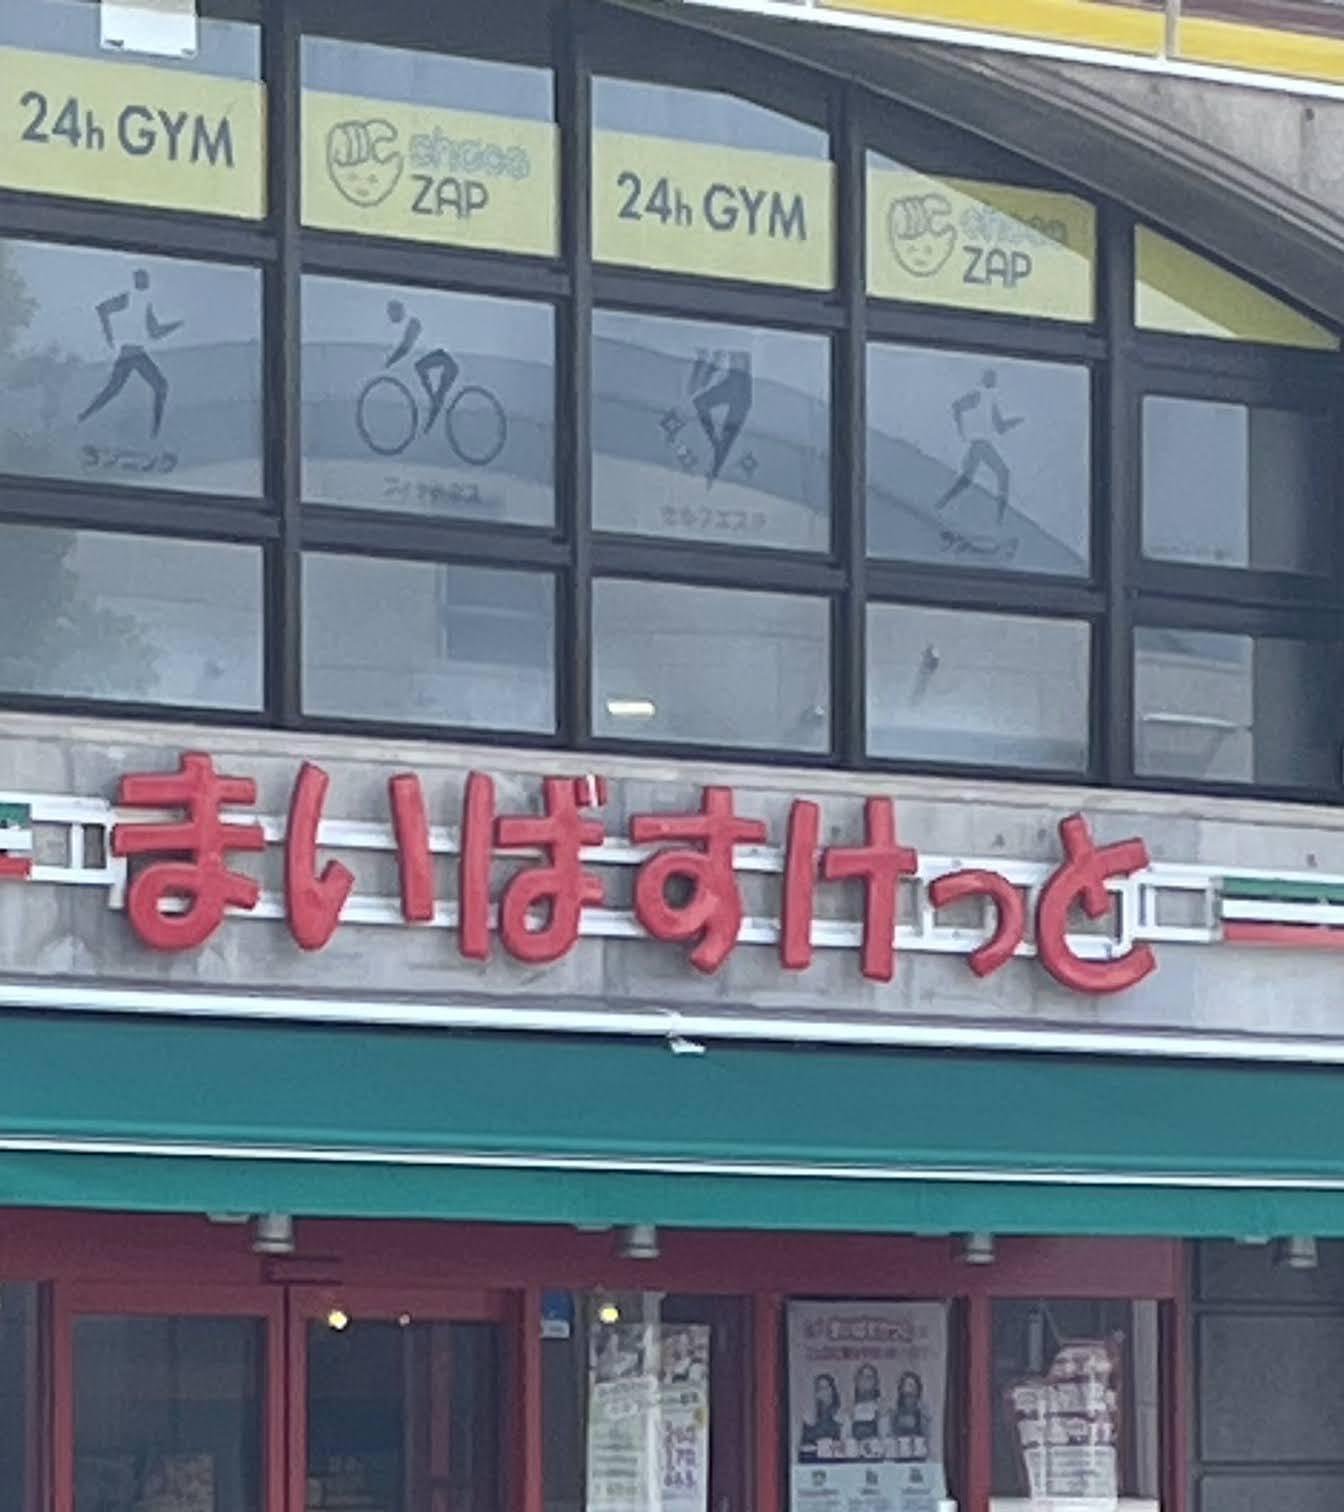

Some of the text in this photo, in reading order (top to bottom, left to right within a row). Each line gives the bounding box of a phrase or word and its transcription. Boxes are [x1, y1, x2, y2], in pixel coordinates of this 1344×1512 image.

[19, 90, 235, 169] 24h GYM
[411, 174, 489, 217] ZAP
[616, 171, 808, 242] 24h GYM
[962, 244, 1033, 289] ZAP
[111, 751, 1158, 996] まいばすけっと
